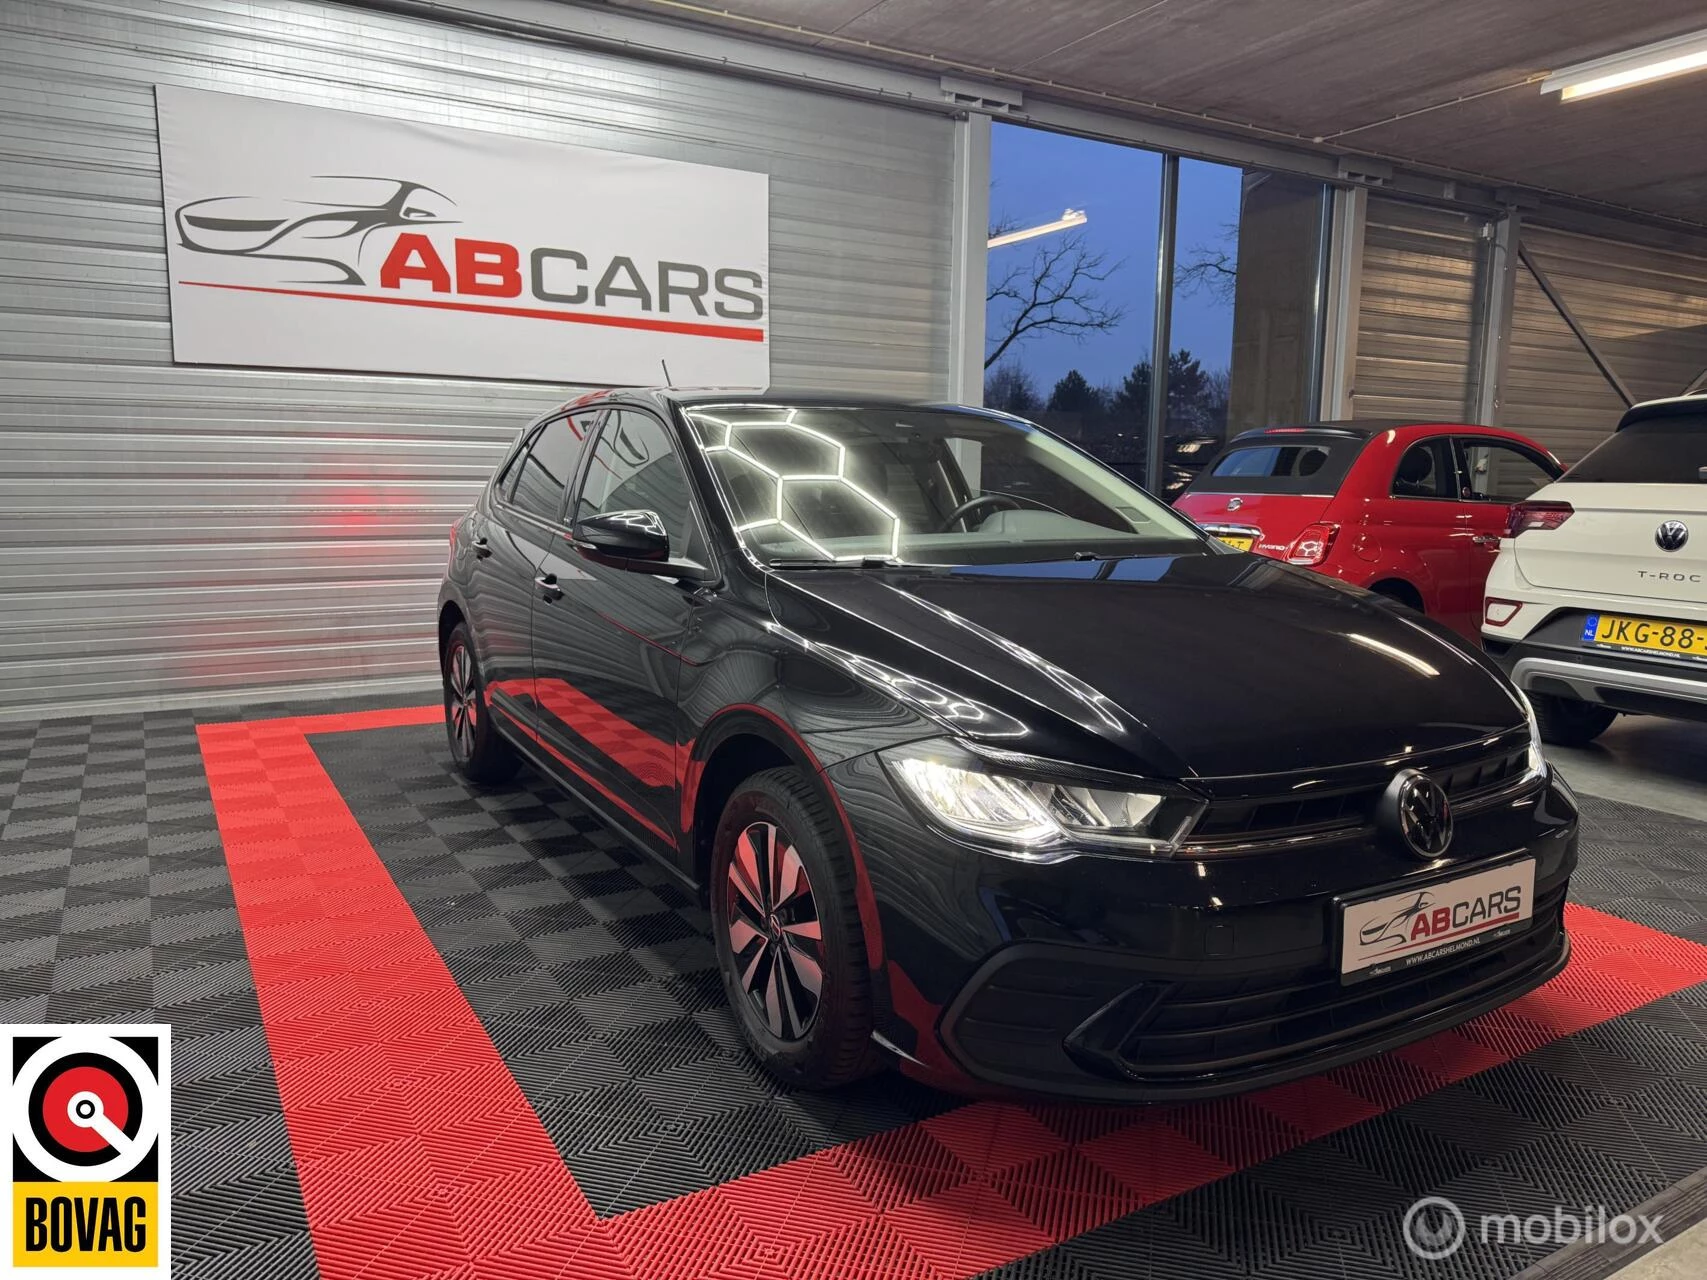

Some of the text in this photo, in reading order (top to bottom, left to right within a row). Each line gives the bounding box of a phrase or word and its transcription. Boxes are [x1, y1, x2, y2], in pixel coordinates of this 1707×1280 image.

[380, 231, 764, 321] ABCARS
[1638, 570, 1701, 583] T-ROC
[1585, 629, 1594, 637] NL
[1410, 885, 1522, 941] ABCARS
[1406, 937, 1481, 966] WWW.ABCARSHELMOND.NL
